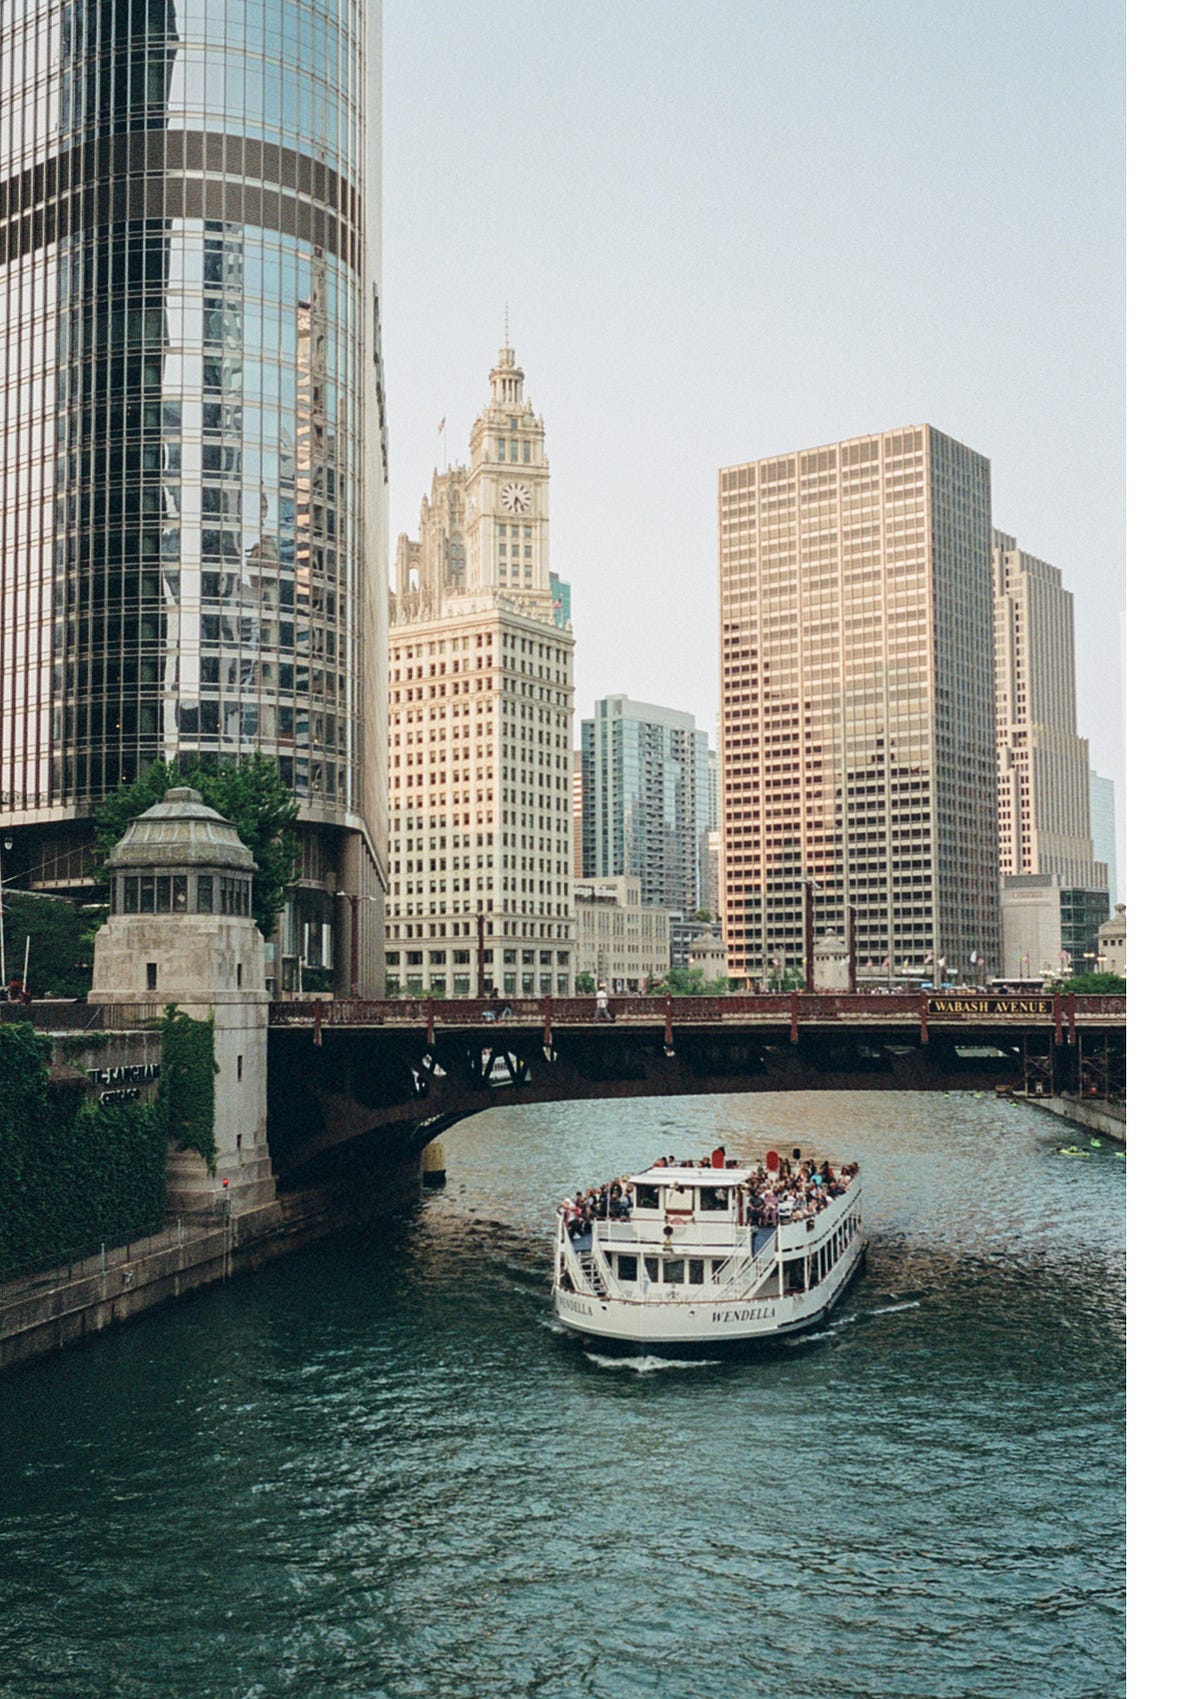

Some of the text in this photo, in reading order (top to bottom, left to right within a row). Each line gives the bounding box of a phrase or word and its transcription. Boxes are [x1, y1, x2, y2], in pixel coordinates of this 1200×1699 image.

[935, 1001, 1047, 1012] WABASH AVENUE
[712, 1307, 776, 1322] WENDELLA
